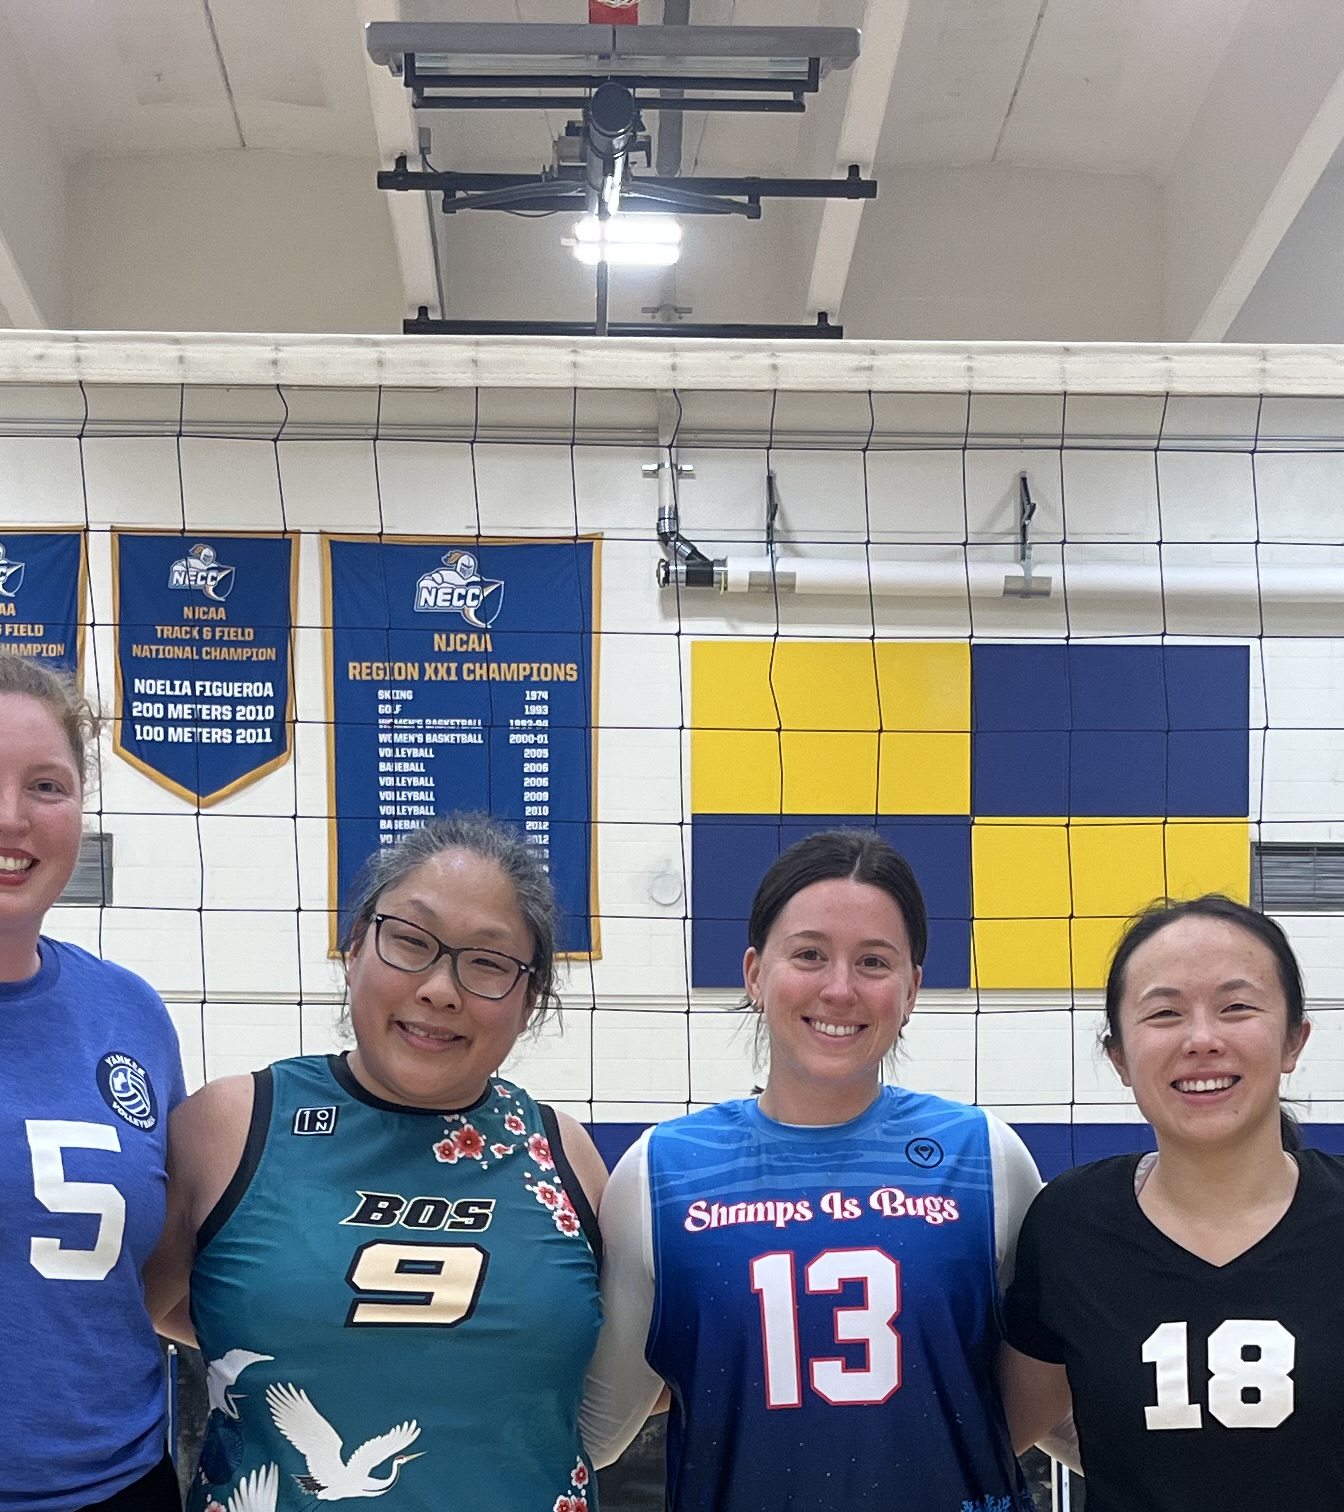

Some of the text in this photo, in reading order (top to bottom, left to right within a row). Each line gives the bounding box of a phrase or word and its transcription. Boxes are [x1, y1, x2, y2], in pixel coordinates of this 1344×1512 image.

[172, 571, 218, 586] NECC
[419, 586, 482, 607] NECC
[183, 606, 226, 620] NJCAA
[5, 625, 44, 637] FIELD
[155, 626, 199, 639] TRACK
[216, 627, 254, 641] FIELD
[434, 633, 493, 652] NJCAA
[132, 644, 276, 661] NATIONAL CHAMPION
[348, 662, 578, 682] REGION XXI CHAMPIONS
[134, 679, 274, 697] NOELIA FIGUEROA
[378, 690, 549, 701] SKIING 1974
[132, 702, 274, 721] 200 METERS 2010
[524, 705, 549, 715] 1993
[135, 725, 273, 744] 100 METERS 2011
[425, 734, 483, 744] BASKETBALL
[509, 734, 549, 744] 2000-01
[525, 821, 549, 830] 2012
[340, 1190, 497, 1232] BOS
[684, 1187, 959, 1232] Shrimps Is Bugs
[344, 1238, 491, 1329] 9
[750, 1246, 903, 1410] 13
[1142, 1319, 1297, 1431] 18
